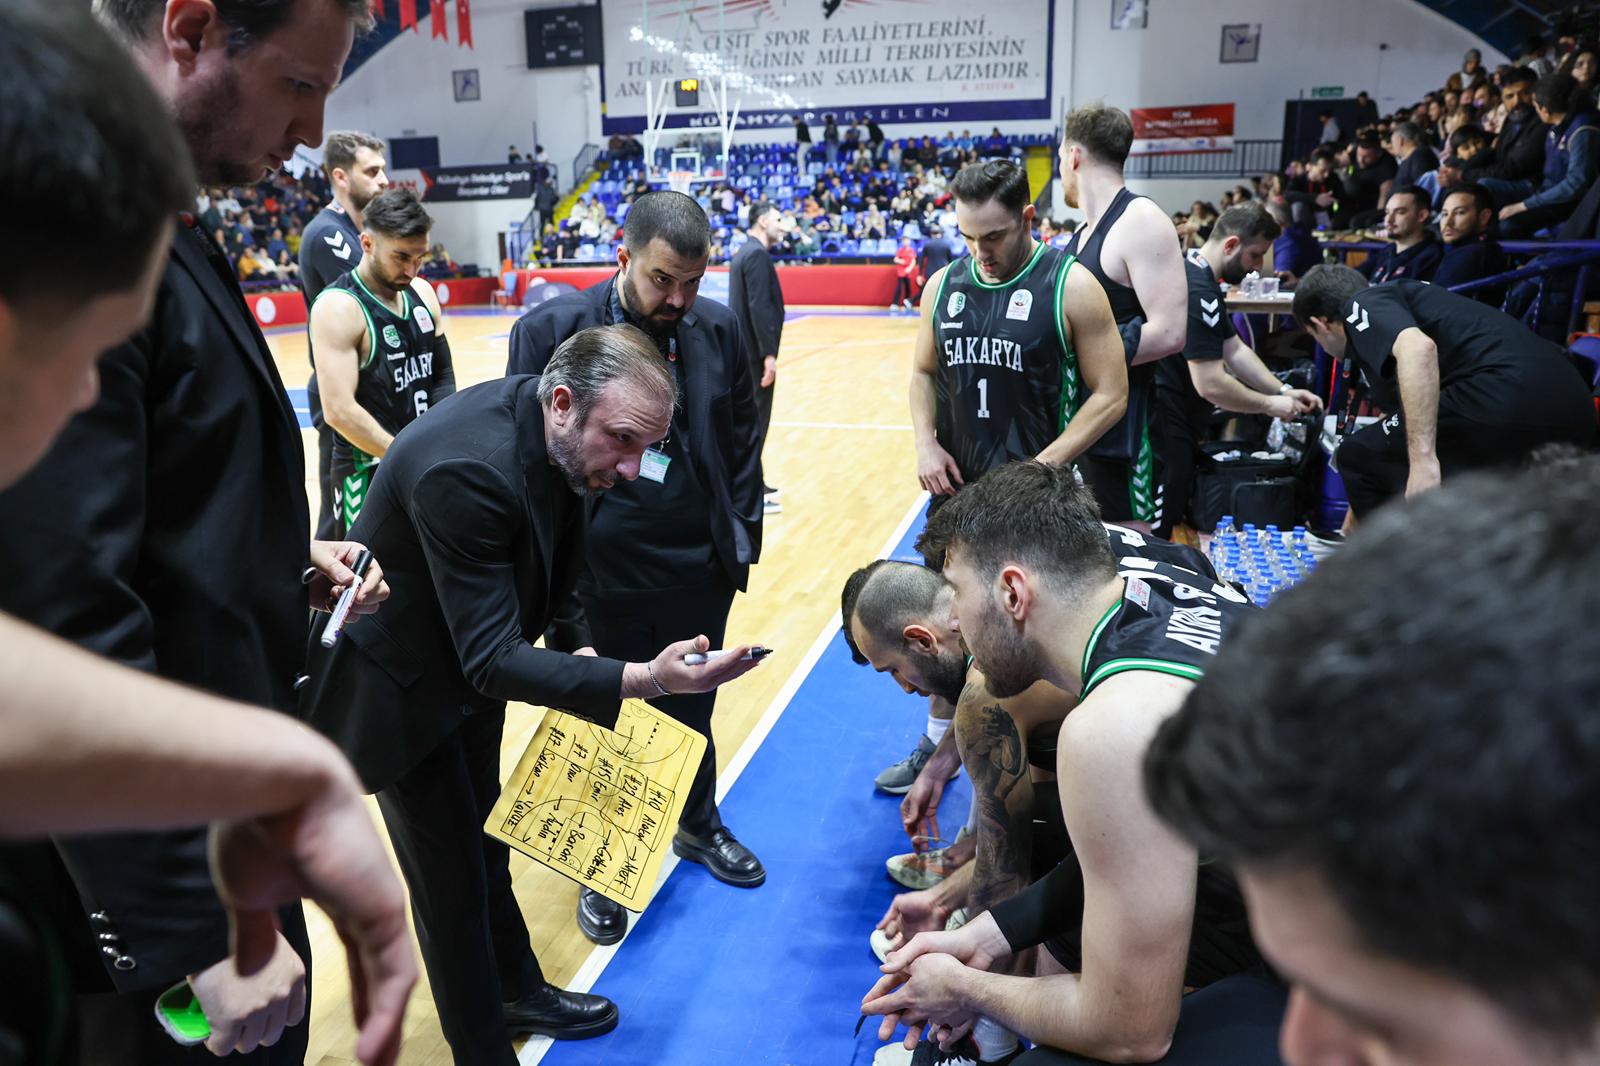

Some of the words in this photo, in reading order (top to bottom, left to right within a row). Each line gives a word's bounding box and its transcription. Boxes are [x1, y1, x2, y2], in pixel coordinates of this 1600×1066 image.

[763, 29, 811, 46] SPOR
[816, 45, 872, 66] MİLLİ
[885, 36, 1026, 62] TERBİYESİNİN
[835, 66, 915, 87] SAYMAK
[944, 337, 1024, 373] SAKARYA
[977, 378, 990, 419] 1
[558, 829, 586, 862] Baran
